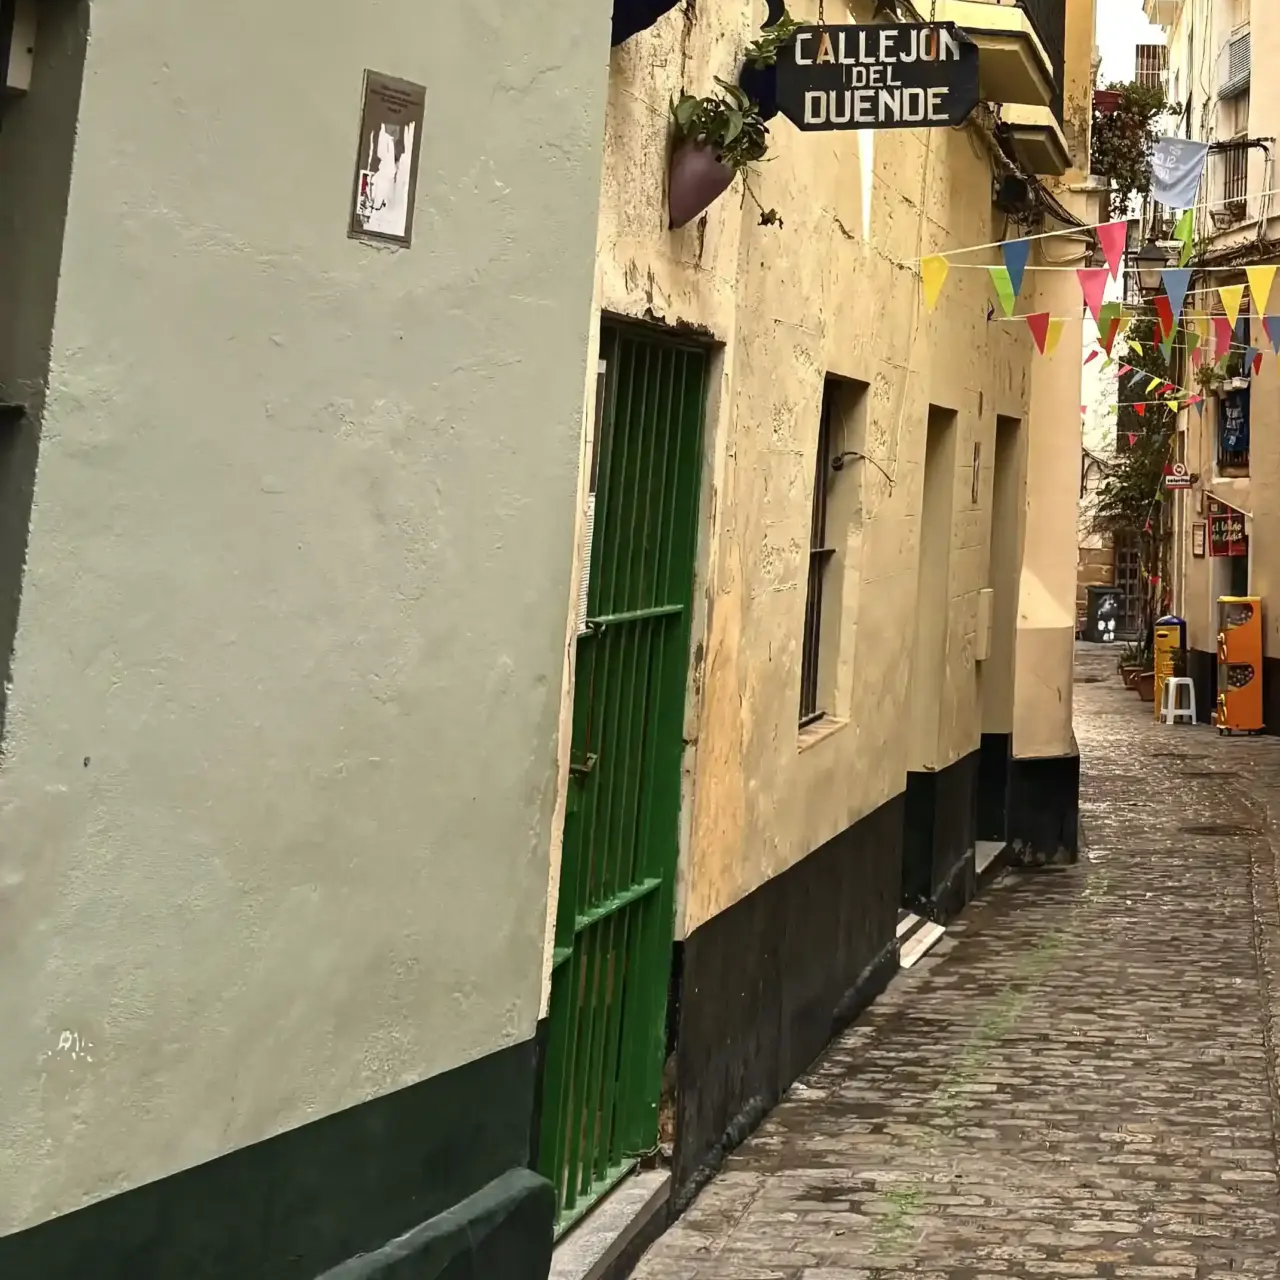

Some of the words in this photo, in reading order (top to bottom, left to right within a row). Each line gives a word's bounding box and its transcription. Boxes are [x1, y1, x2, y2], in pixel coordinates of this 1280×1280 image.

[795, 28, 960, 65] CALLEJON
[852, 65, 901, 87] DEL
[804, 86, 949, 125] DUENDE
